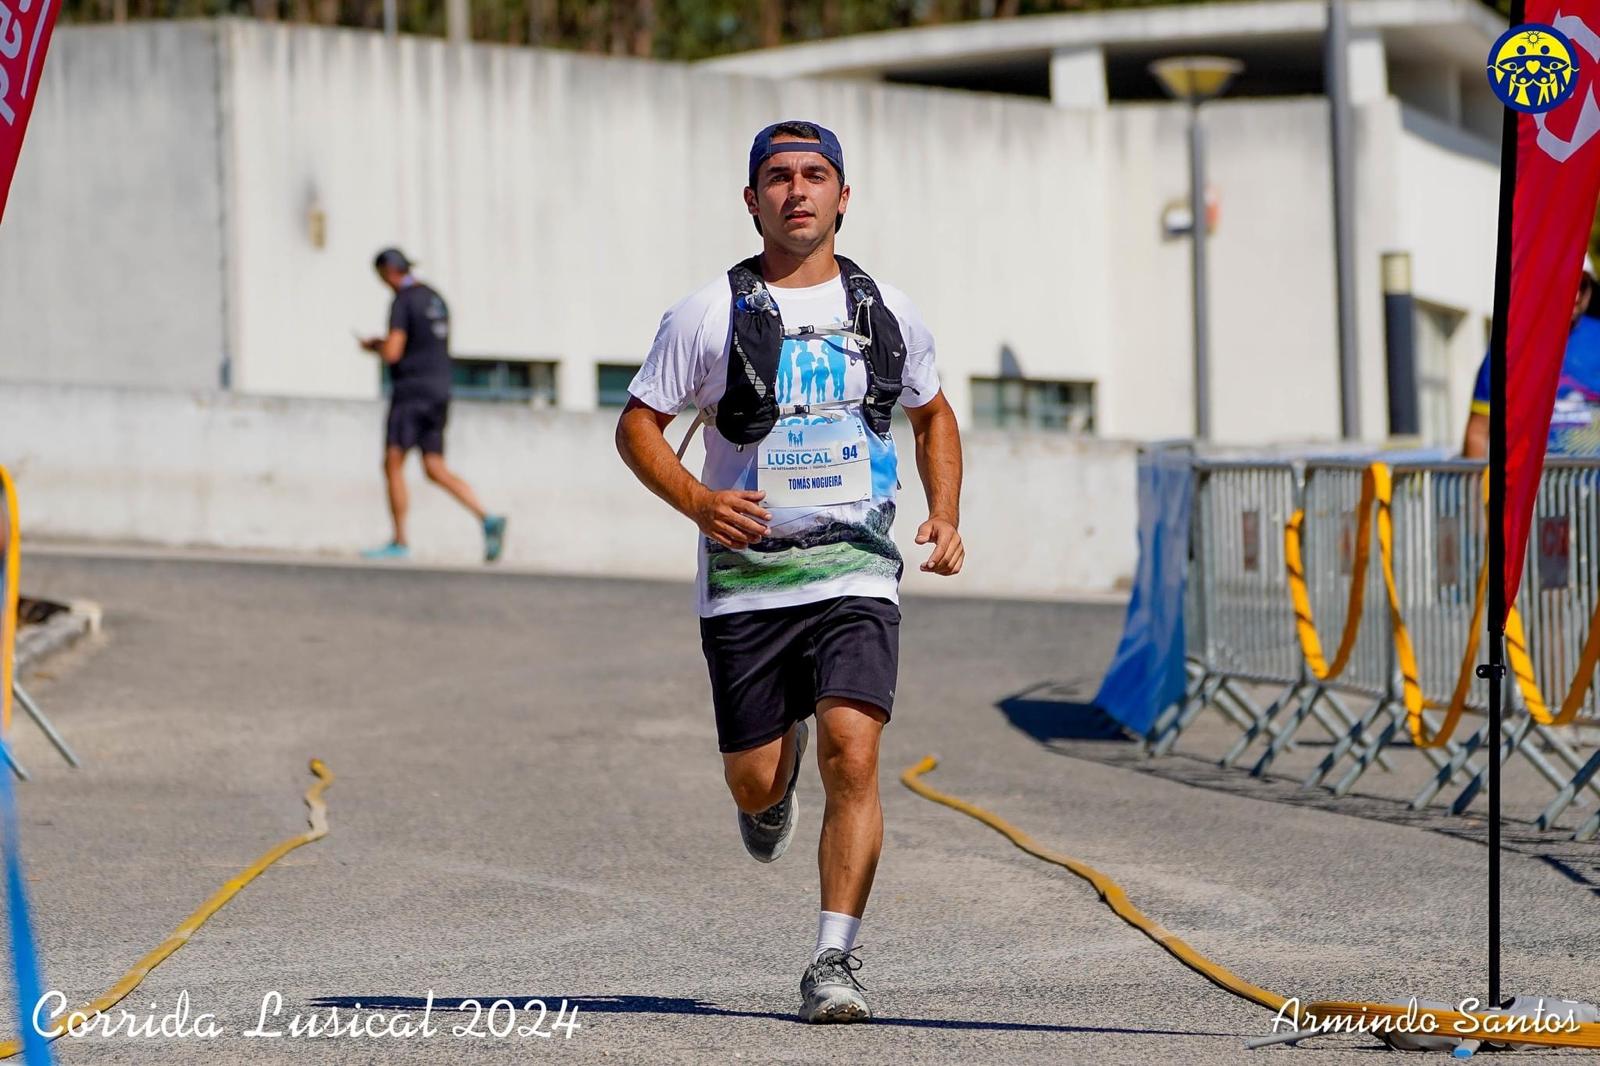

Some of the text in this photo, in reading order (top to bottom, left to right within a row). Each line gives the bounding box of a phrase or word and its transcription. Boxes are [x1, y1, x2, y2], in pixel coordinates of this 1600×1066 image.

[768, 452, 832, 464] LUSICAL
[842, 445, 858, 460] 94
[788, 476, 842, 490] TOMÁS NOGUEIRA
